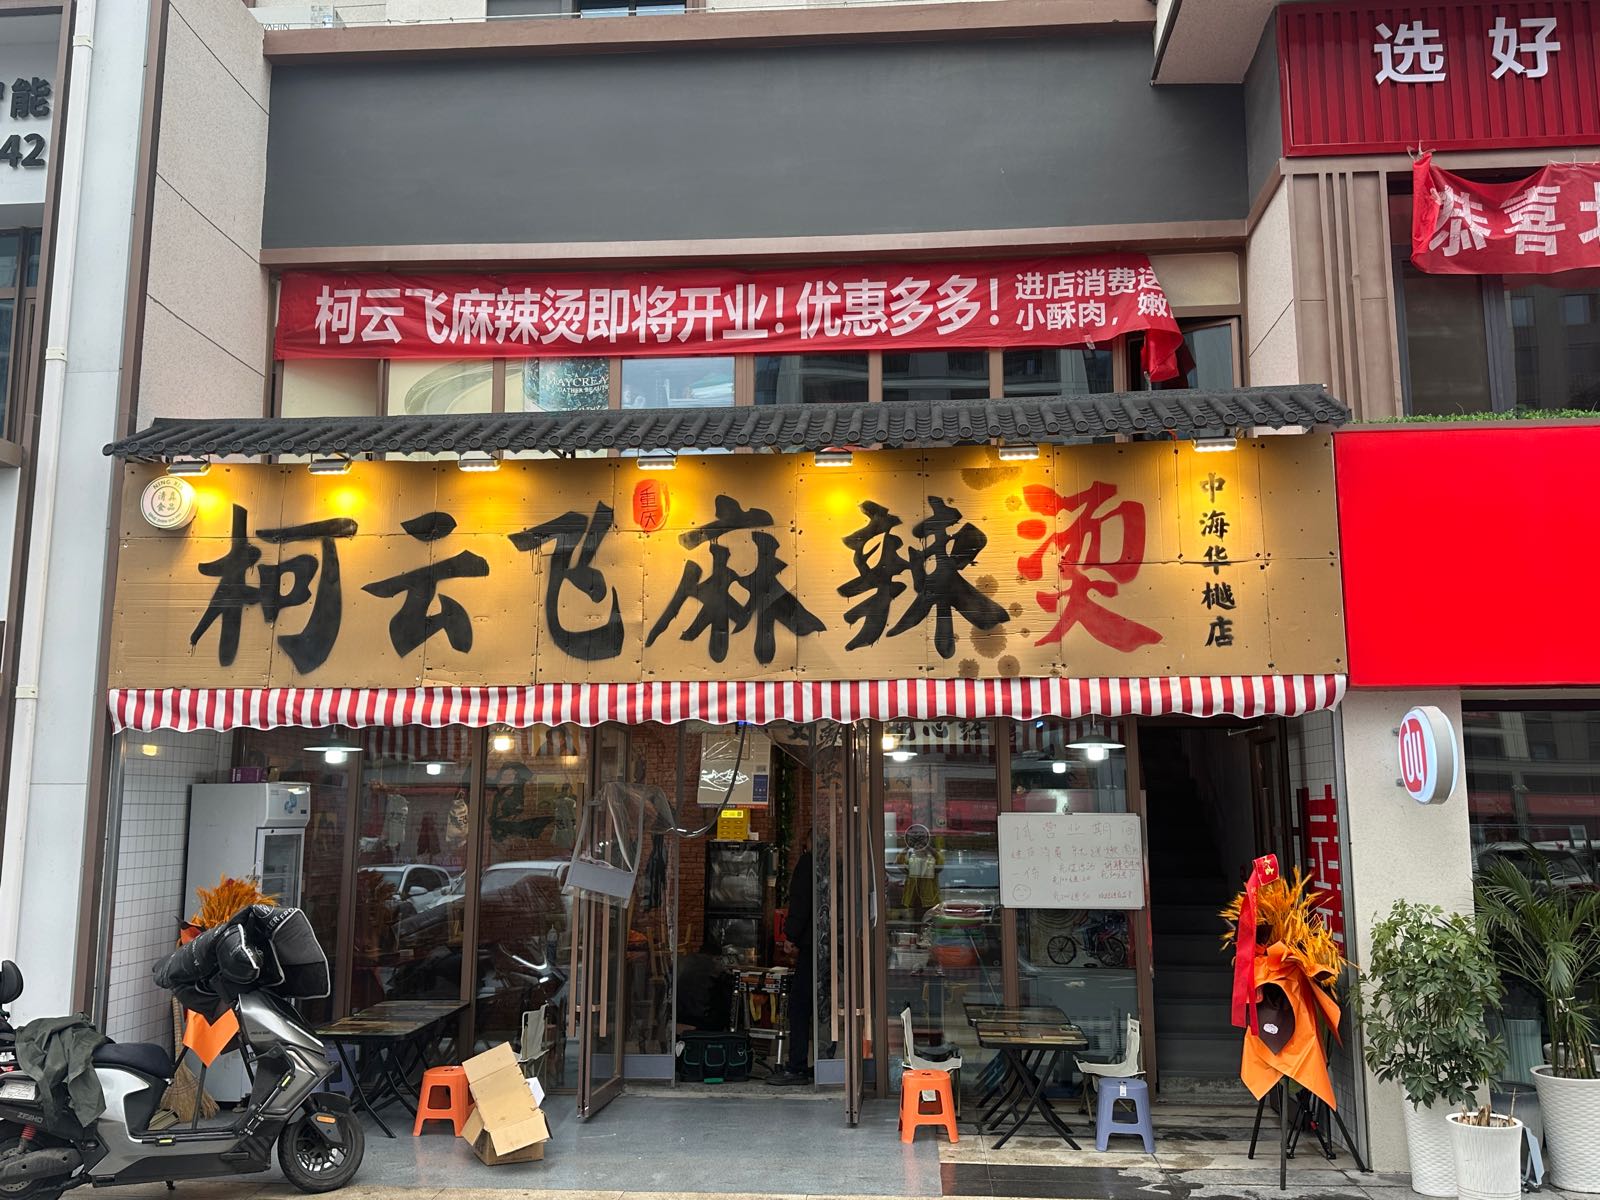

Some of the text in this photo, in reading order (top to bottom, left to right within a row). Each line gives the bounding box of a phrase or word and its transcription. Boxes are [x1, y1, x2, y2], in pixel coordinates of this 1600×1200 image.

[0, 77, 51, 118] 能
[189, 480, 1164, 675] 柯云飞麻辣烫
[1199, 472, 1237, 648] 中海华樾店
